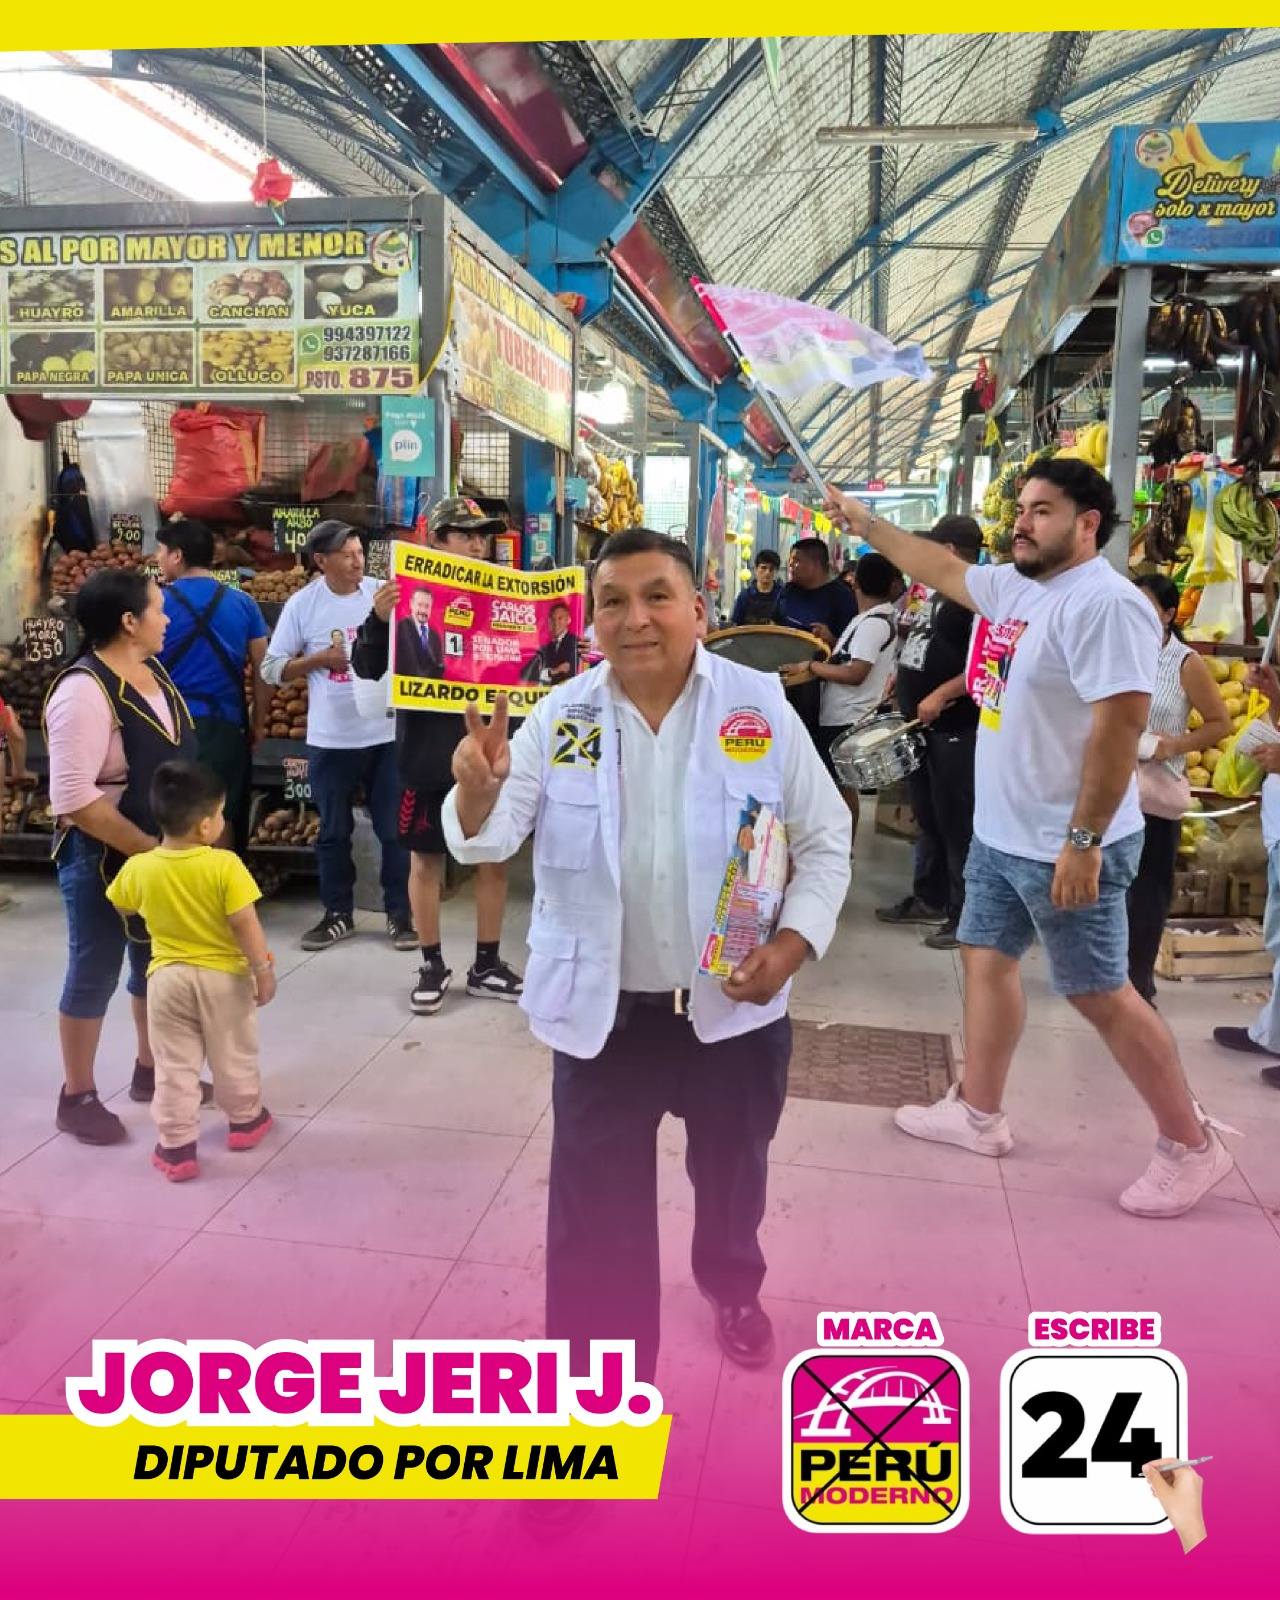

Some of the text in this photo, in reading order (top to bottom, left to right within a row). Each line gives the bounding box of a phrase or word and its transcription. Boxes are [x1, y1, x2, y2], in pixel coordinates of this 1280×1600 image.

[1156, 163, 1260, 199] Delivery
[1154, 199, 1277, 222] solo x mayor
[22, 237, 57, 265] AL
[60, 235, 120, 263] POR
[124, 230, 228, 262] MAYOR
[231, 231, 252, 259] Y
[257, 228, 367, 260] MENOR
[18, 306, 85, 319] HUAYRO
[110, 304, 188, 317] AMARILLA
[207, 304, 291, 319] CANCHAN
[326, 304, 376, 317] YUCA
[323, 325, 411, 342] 994397122
[323, 345, 410, 362] 937287166
[16, 371, 90, 382] PAPA NEGRA
[107, 371, 188, 382] PAPA UNICA
[215, 370, 283, 383] OLLUCO
[305, 367, 413, 389] PSTO. 875
[395, 440, 418, 453] plin
[404, 554, 481, 586] ERRADICAR
[498, 574, 575, 596] EXTORSIÓN
[492, 600, 536, 614] CARLOS
[492, 610, 536, 625] JAICO
[450, 635, 458, 654] 1
[400, 680, 479, 701] LIZARDO
